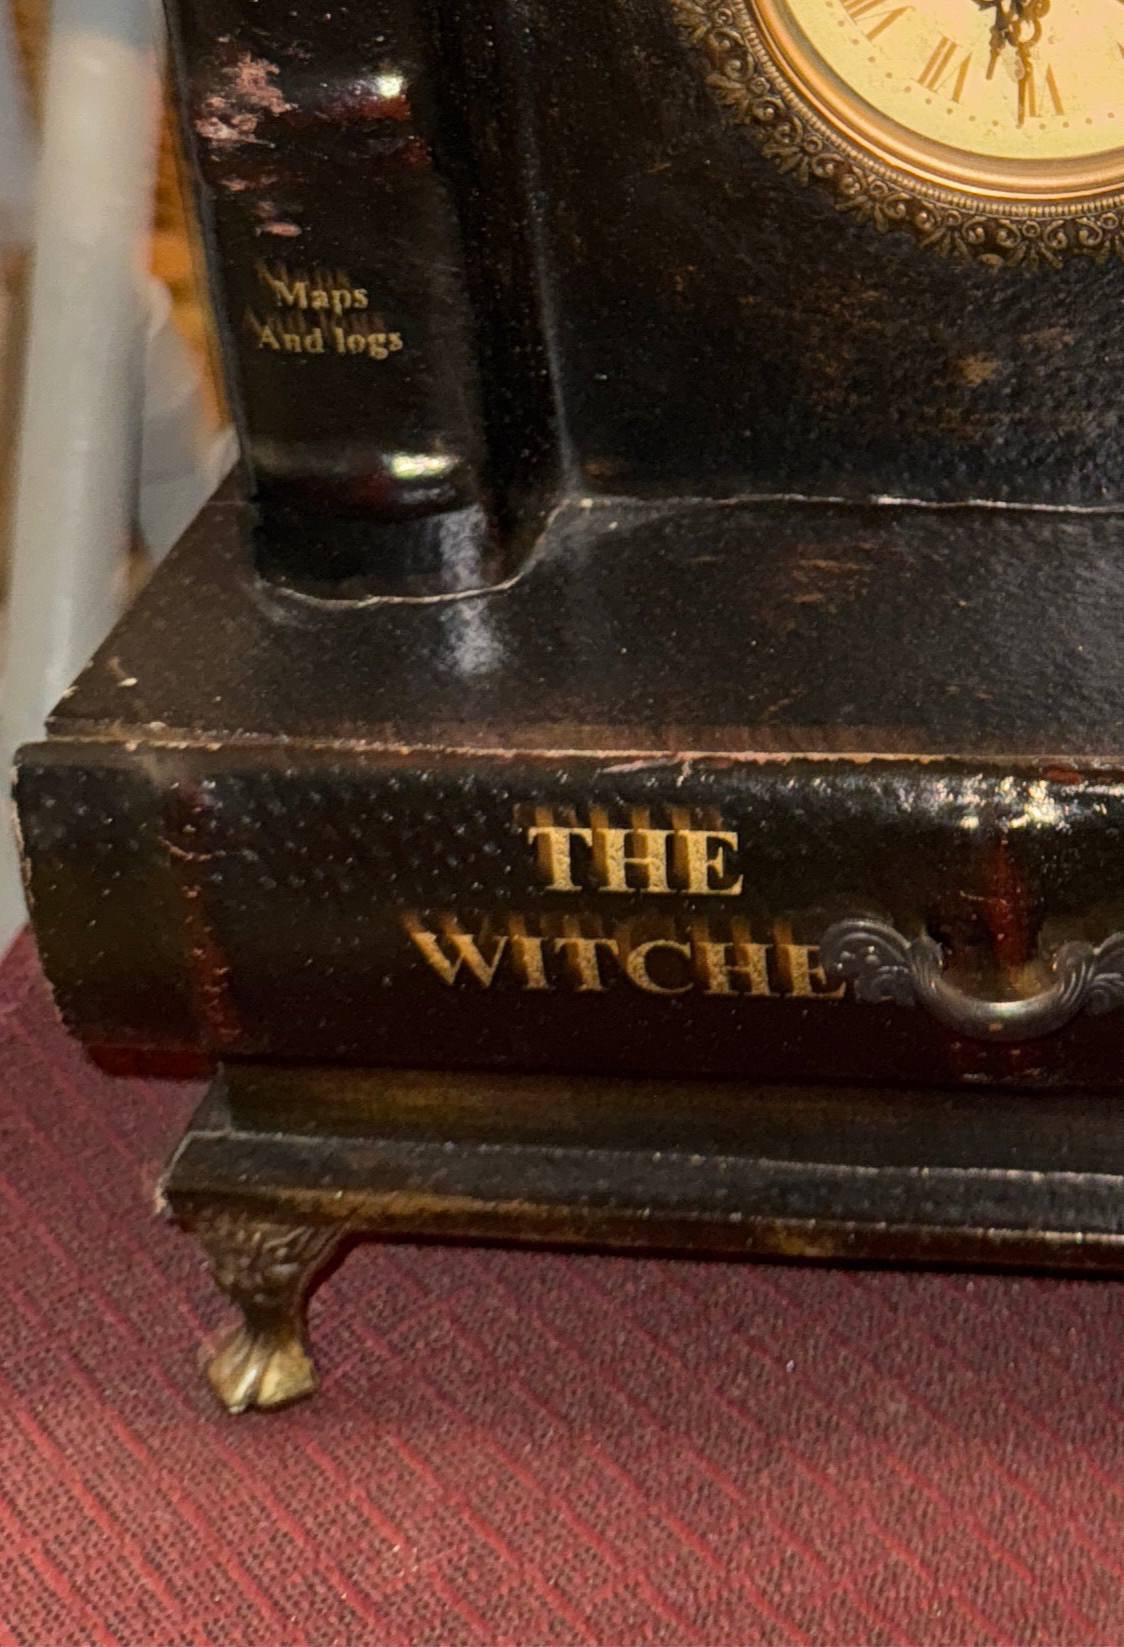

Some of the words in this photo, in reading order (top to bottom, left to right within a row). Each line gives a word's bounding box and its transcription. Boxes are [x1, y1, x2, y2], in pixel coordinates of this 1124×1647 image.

[915, 34, 972, 104] VII
[272, 279, 369, 316] Maps
[258, 325, 325, 354] And
[333, 327, 404, 361] logs
[527, 826, 744, 897] THE
[408, 930, 893, 1001] WITCHE
